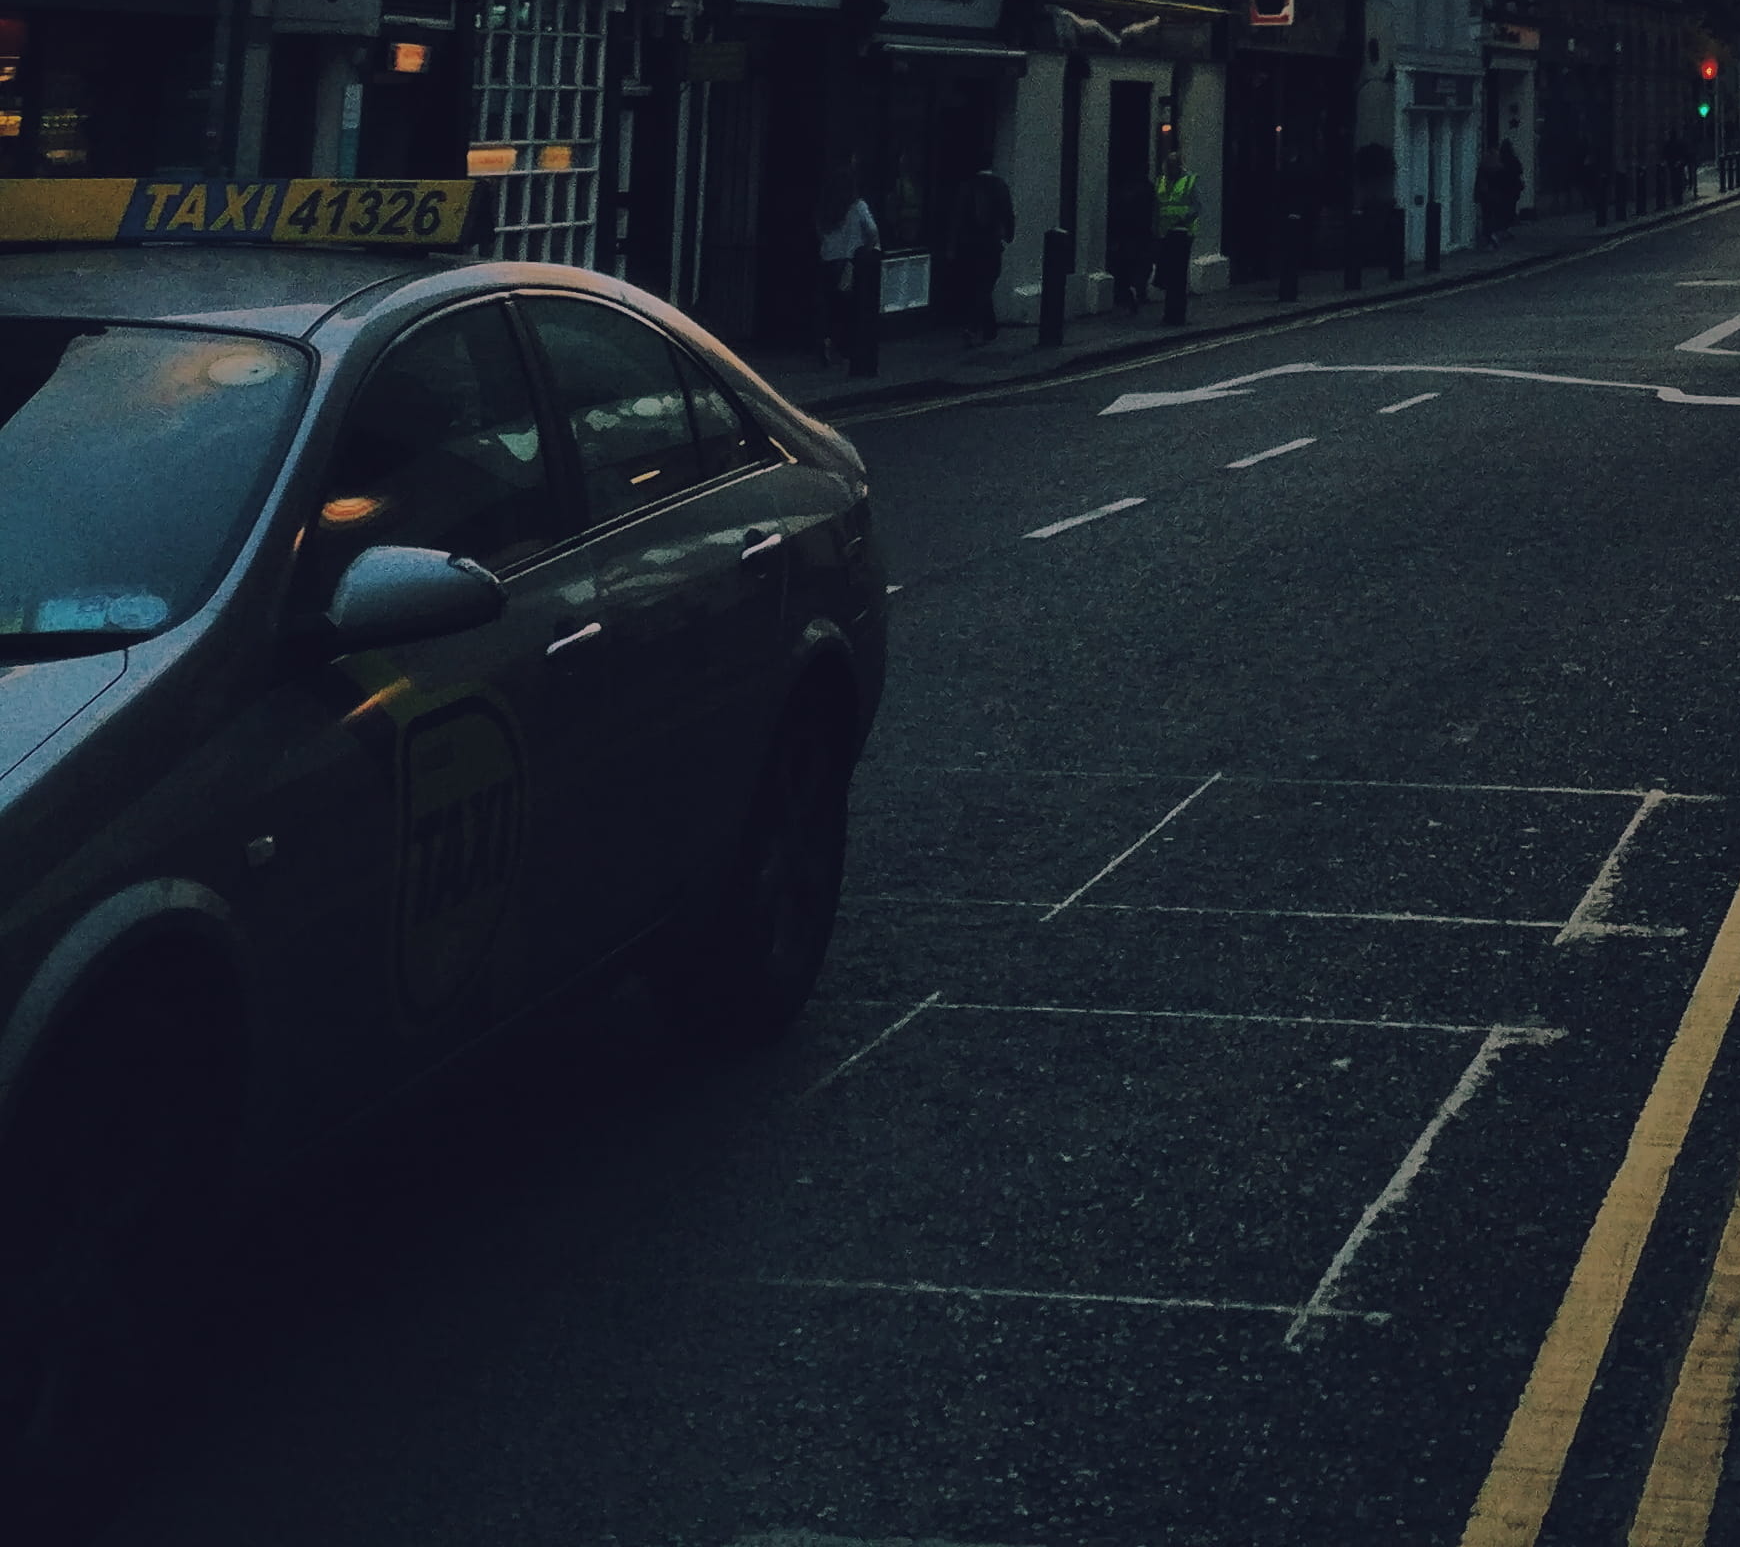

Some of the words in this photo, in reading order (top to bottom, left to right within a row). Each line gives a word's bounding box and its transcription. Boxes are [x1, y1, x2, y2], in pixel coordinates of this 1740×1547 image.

[145, 184, 277, 232] TAXI
[288, 189, 447, 236] 41326
[411, 781, 513, 923] TAXI
